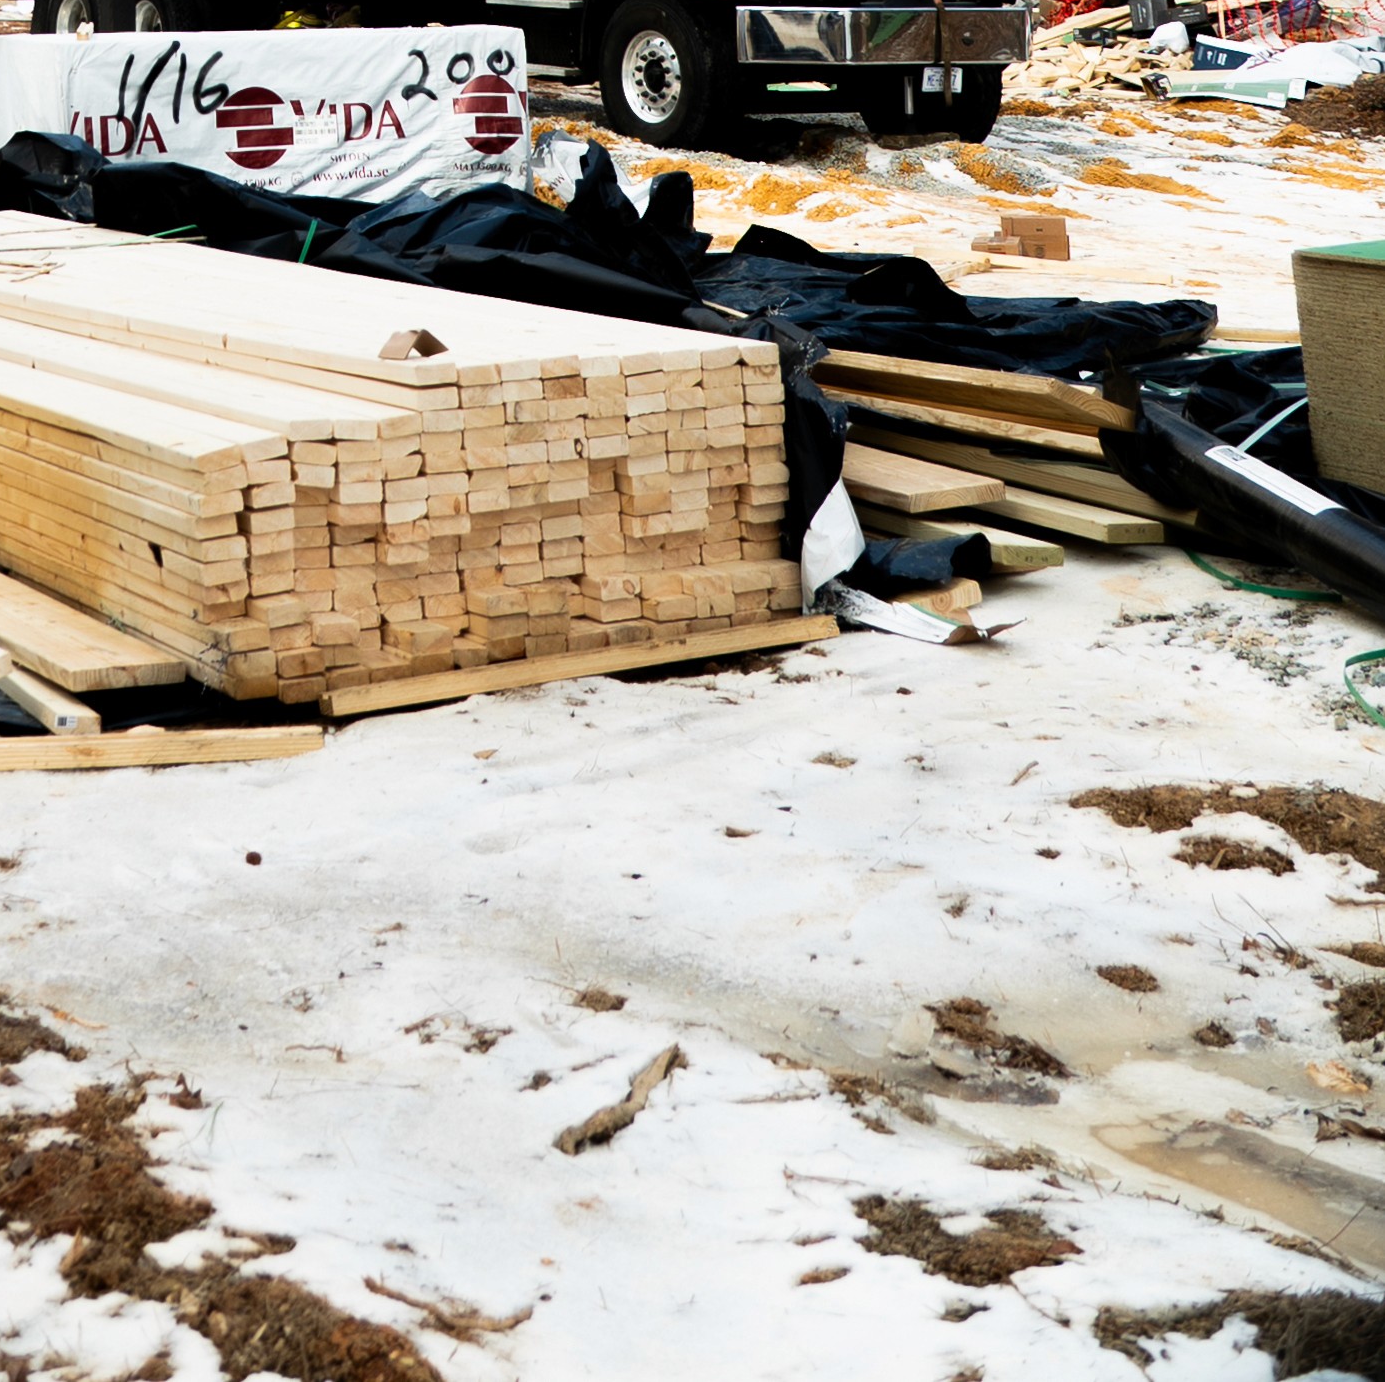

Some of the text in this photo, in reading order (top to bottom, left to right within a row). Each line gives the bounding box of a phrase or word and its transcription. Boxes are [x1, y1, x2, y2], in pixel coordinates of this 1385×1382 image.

[401, 48, 516, 101] 200
[114, 40, 230, 150] 1/16
[330, 152, 371, 164] SWEDEN
[268, 176, 282, 186] KG
[313, 167, 389, 182] www.vida.se
